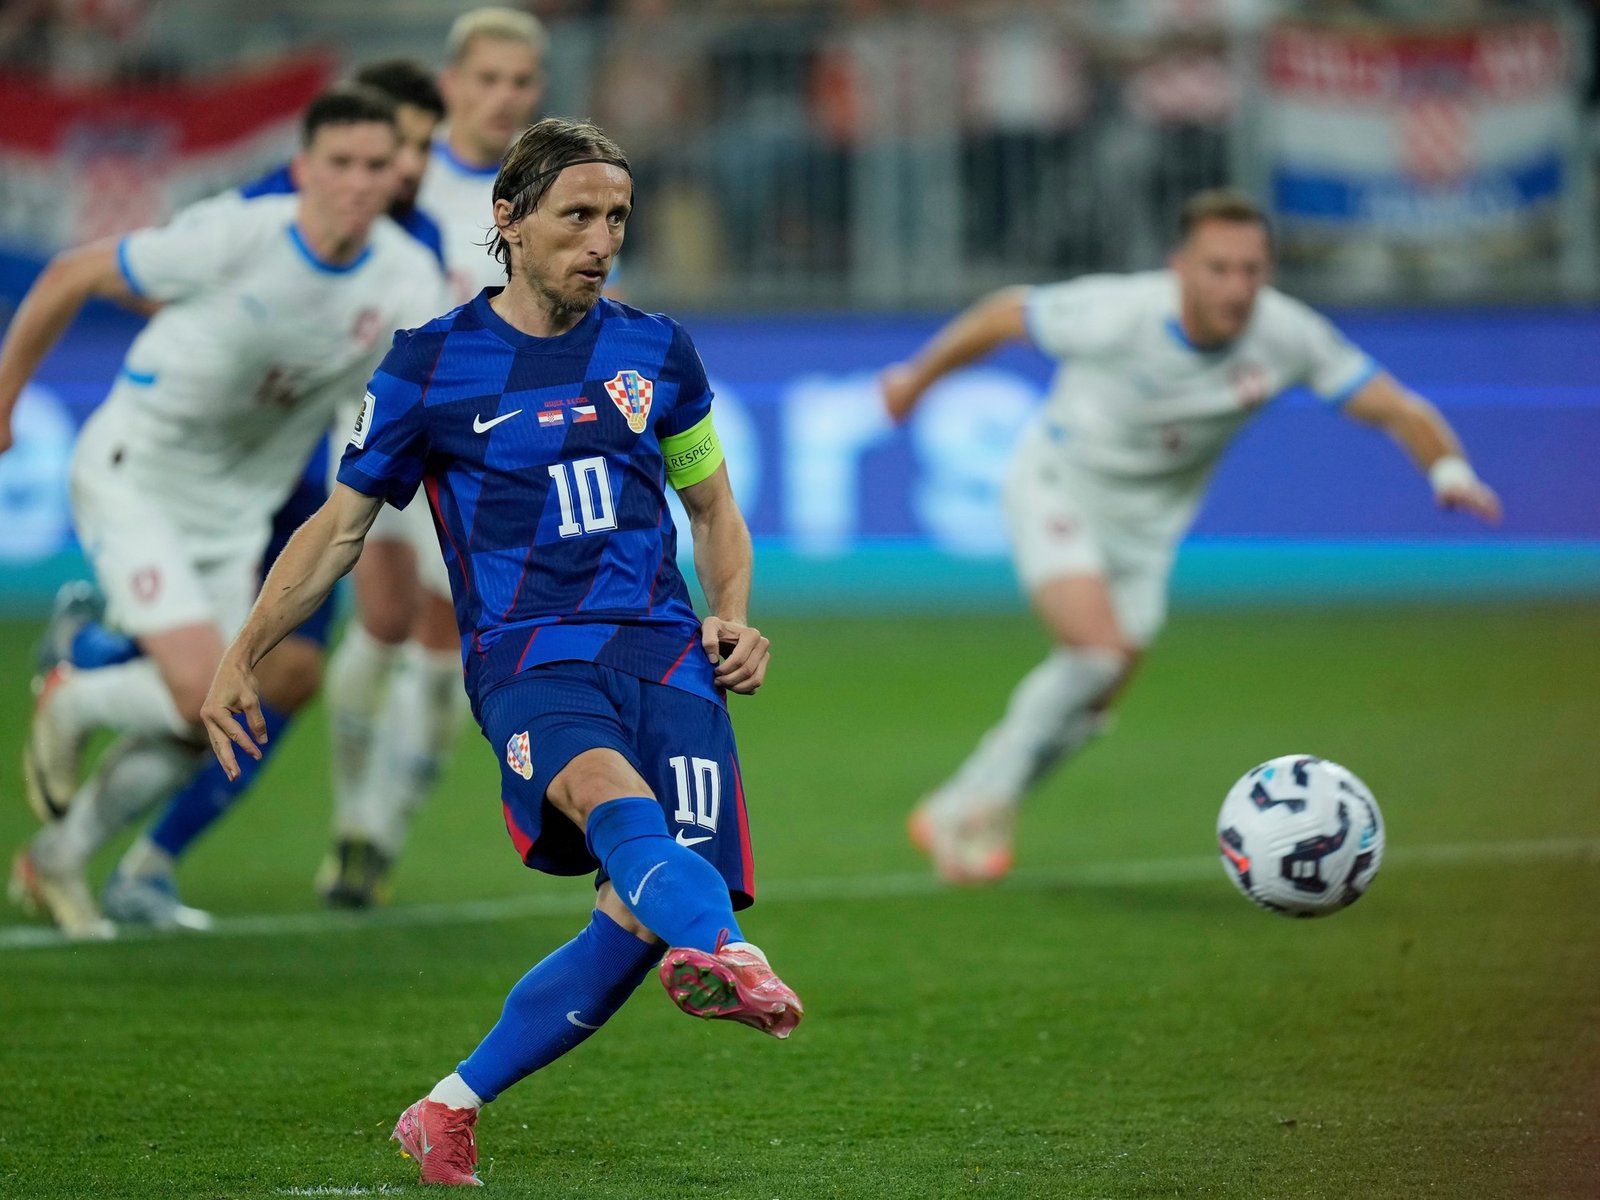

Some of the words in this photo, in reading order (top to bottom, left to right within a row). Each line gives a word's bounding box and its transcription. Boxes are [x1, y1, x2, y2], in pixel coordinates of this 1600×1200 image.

[671, 436, 713, 468] RESPECT
[548, 456, 618, 538] 10
[669, 756, 721, 833] 10
